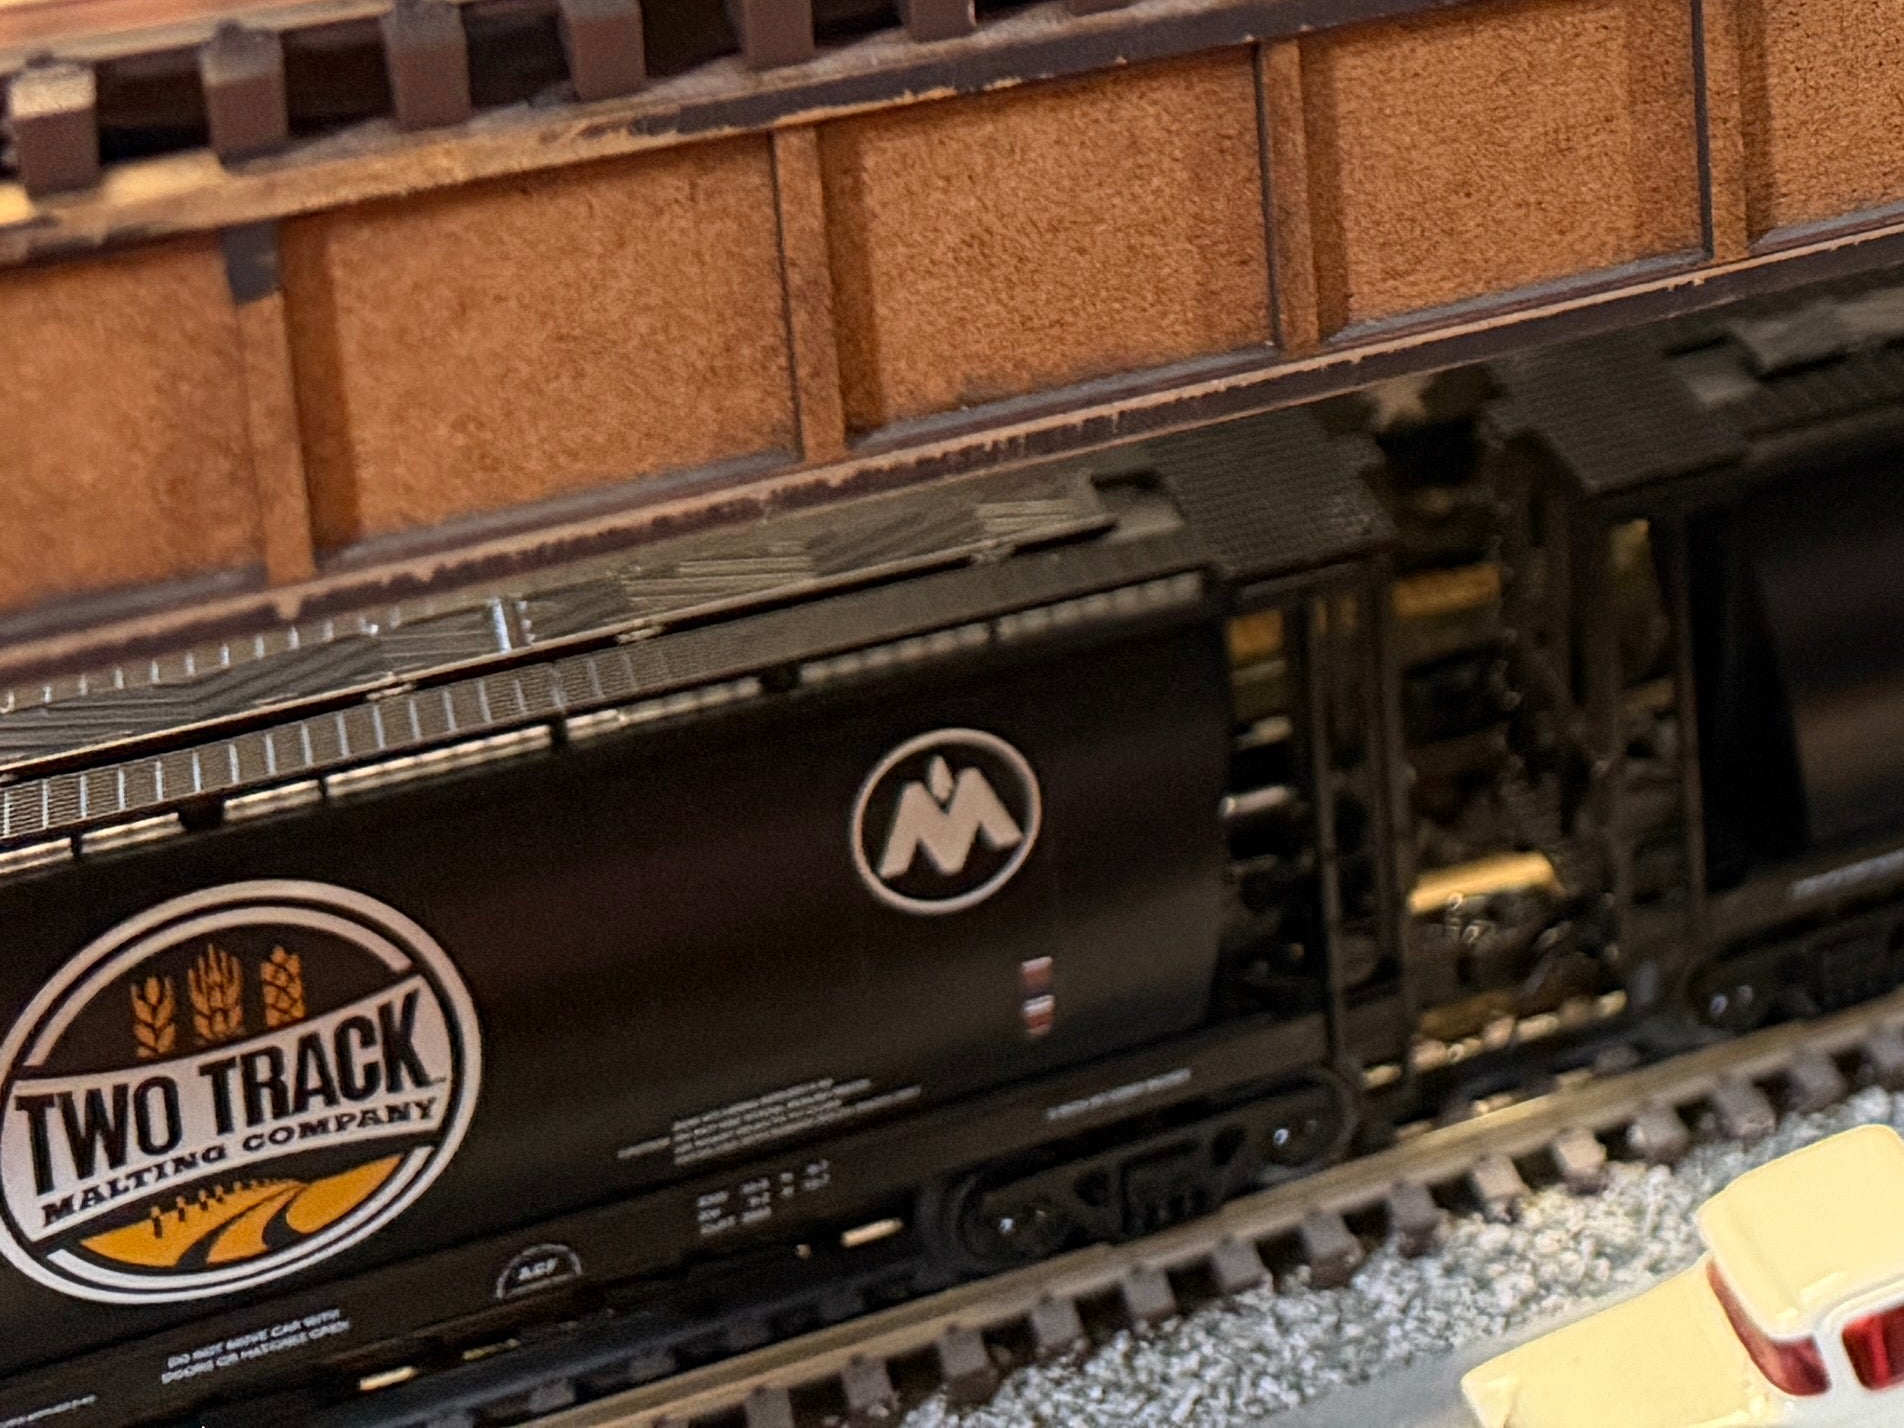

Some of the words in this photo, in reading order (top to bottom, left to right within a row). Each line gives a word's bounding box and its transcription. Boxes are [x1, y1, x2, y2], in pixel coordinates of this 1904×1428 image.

[15, 1075, 184, 1197] TWO
[199, 992, 436, 1137] TRACK
[41, 1146, 227, 1228] MALTING
[242, 1096, 438, 1153] COMPANY
